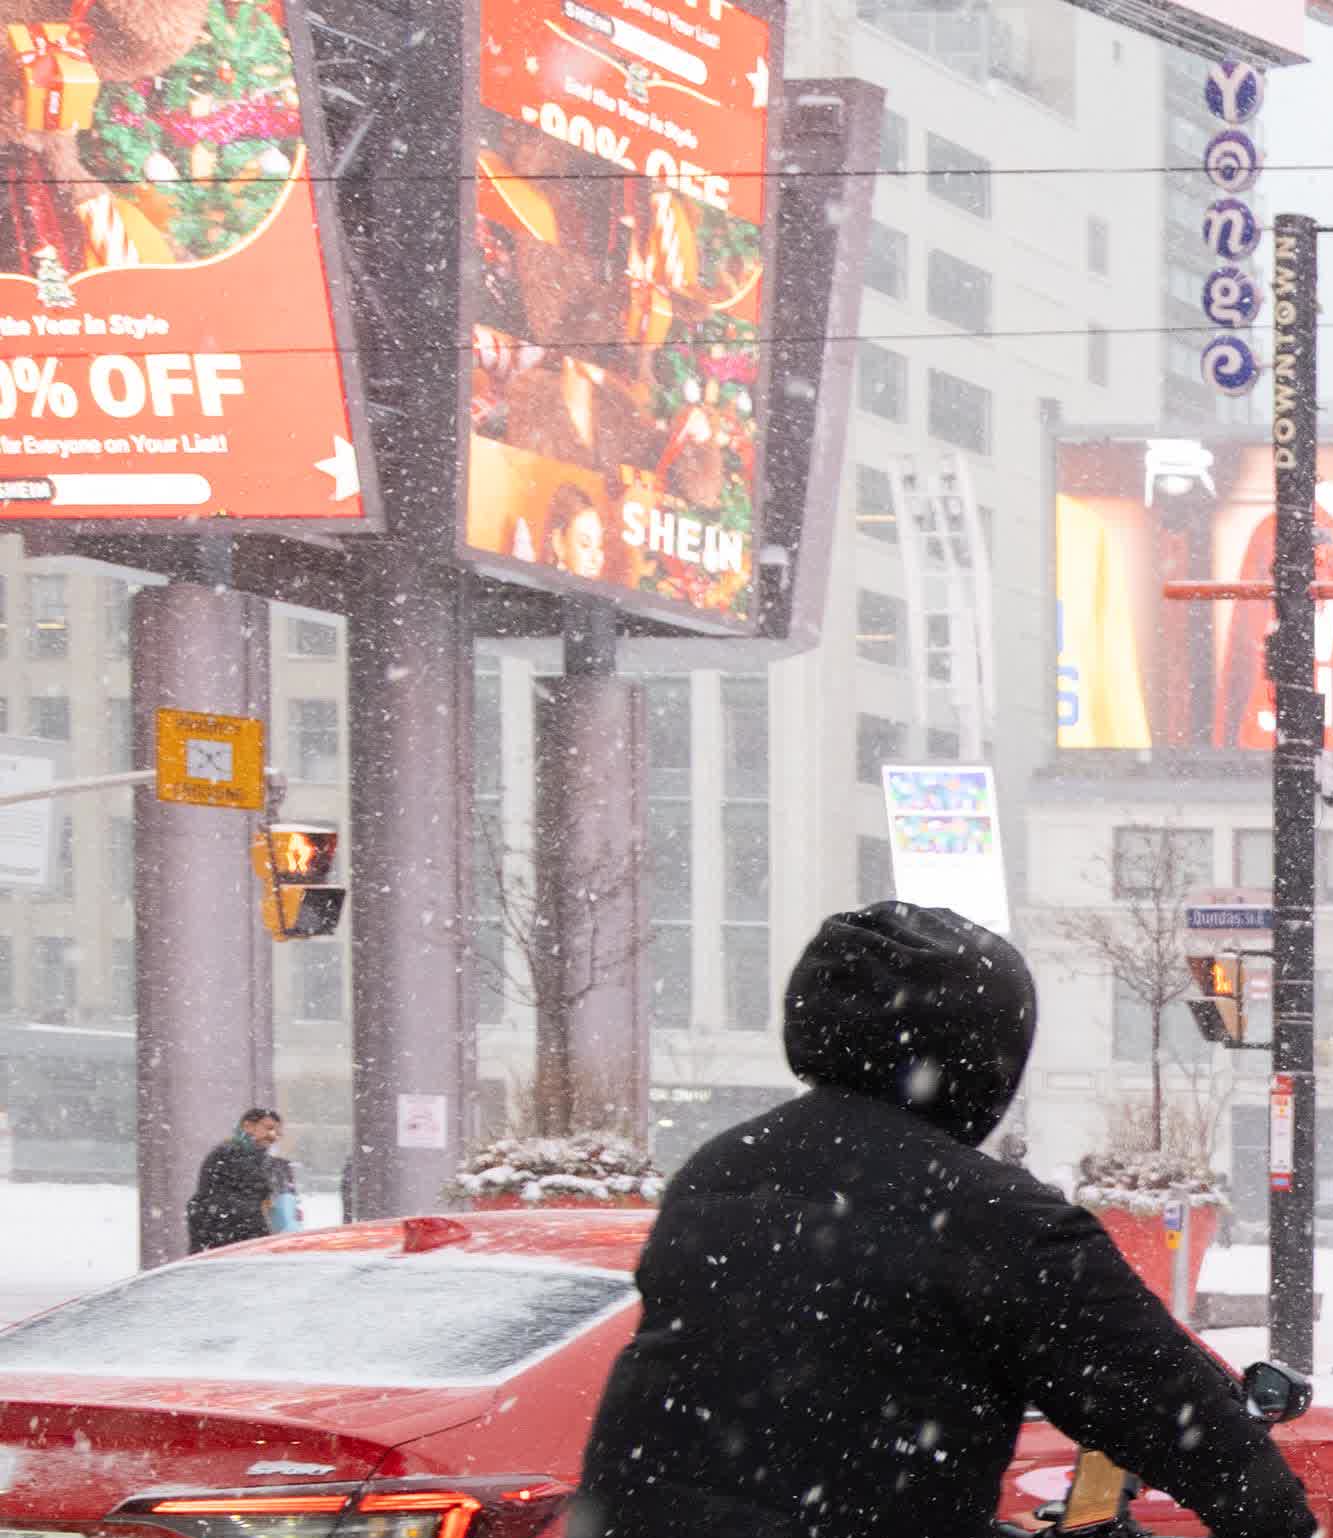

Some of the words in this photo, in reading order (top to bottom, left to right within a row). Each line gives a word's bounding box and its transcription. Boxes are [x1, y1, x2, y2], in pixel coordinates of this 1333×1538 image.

[32, 315, 82, 336] Year
[84, 313, 107, 335] in
[109, 314, 170, 340] Style
[1273, 232, 1300, 470] DOWNTOWN
[89, 353, 245, 419] OFF
[130, 434, 178, 454] Your
[621, 501, 743, 574] SHEIN
